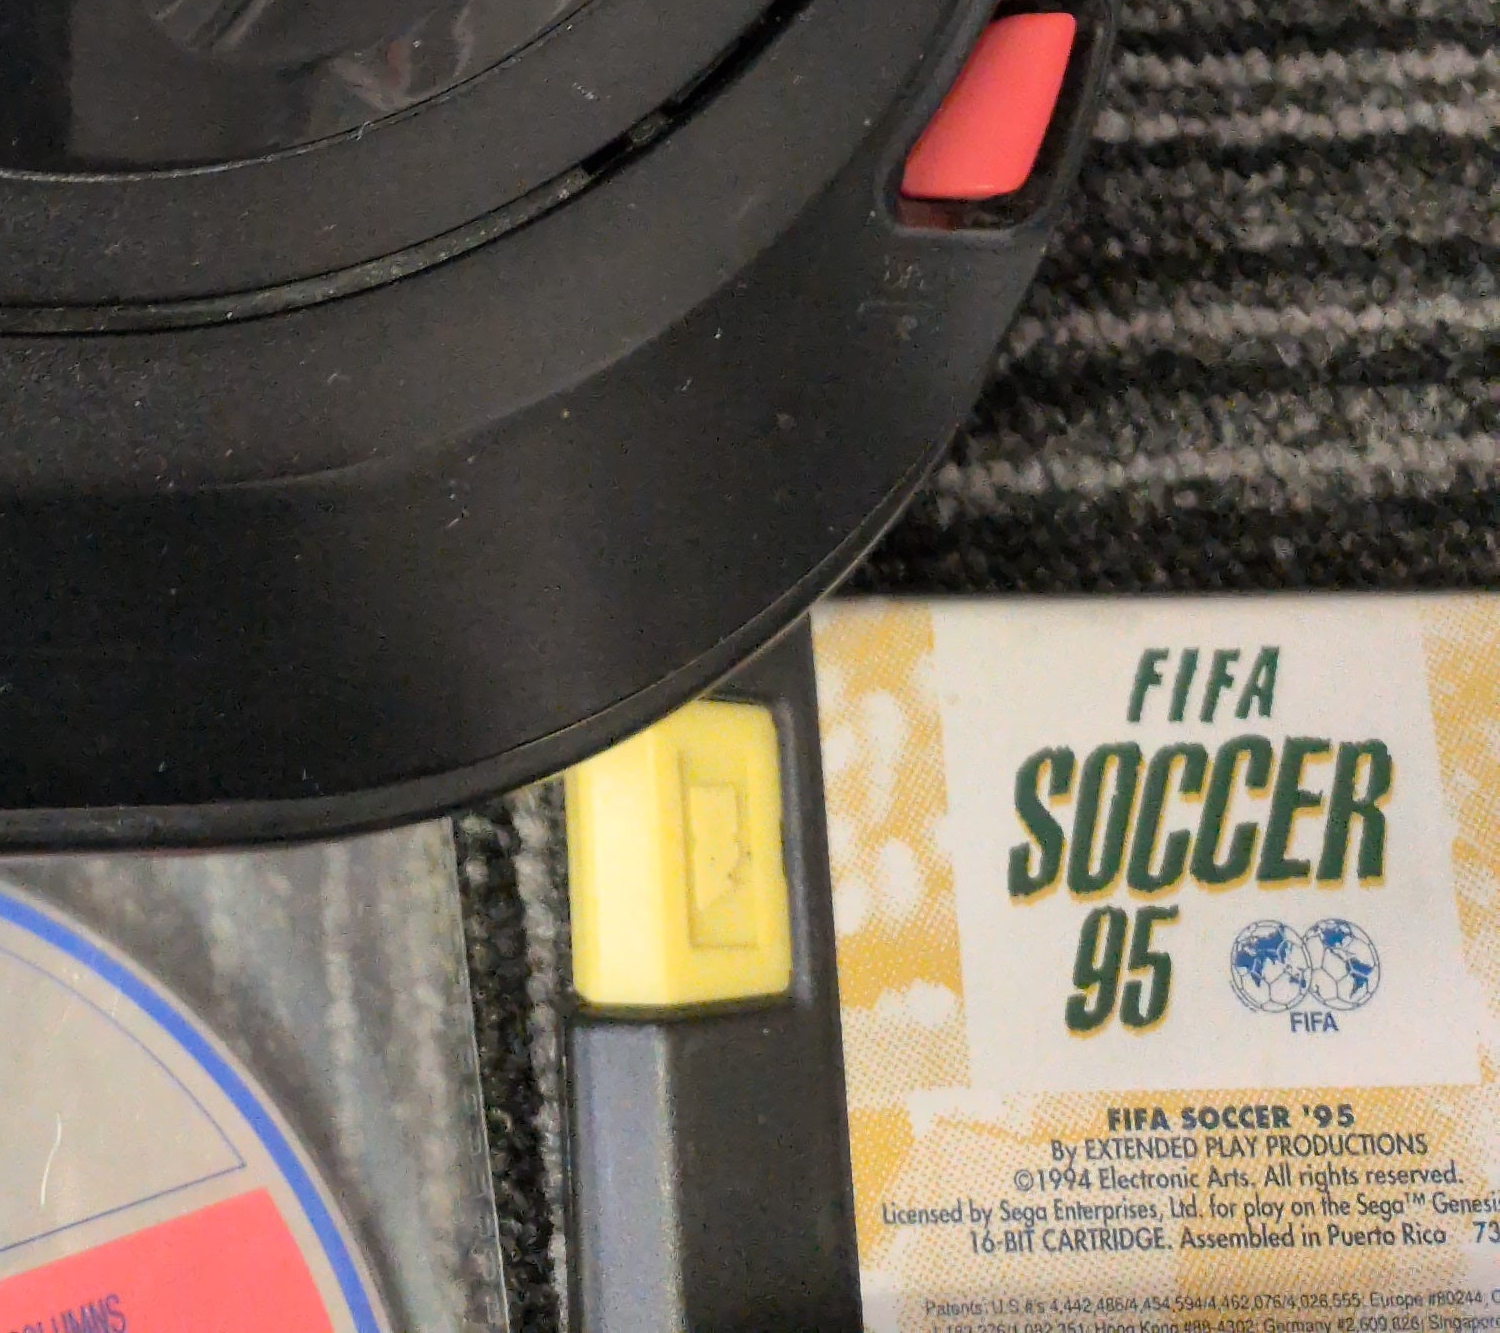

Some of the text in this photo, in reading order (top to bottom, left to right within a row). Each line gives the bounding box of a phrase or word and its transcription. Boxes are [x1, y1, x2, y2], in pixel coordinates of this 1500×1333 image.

[1128, 646, 1280, 723] FIFA
[1008, 734, 1395, 901] SOCCER
[1065, 905, 1180, 1037] 95
[1289, 1011, 1339, 1033] FIFA
[1106, 1103, 1356, 1132] FIFA SOCCER '95
[1050, 1132, 1428, 1169] By EXTENDED PLAY PRODUCTIONS
[1013, 1158, 1465, 1193] ©1994 Electronic Arts. All rights reserved.
[883, 1198, 964, 1226] Licensed
[970, 1200, 994, 1229] by
[1000, 1199, 1049, 1228] Sega
[1054, 1196, 1164, 1226] Enterprises,
[1169, 1193, 1205, 1219] Ltd.
[1209, 1194, 1237, 1219] for
[1244, 1192, 1285, 1226] play
[1291, 1200, 1315, 1217] on
[1321, 1191, 1351, 1217] the
[971, 1229, 1034, 1254] 16-BIT
[1041, 1226, 1173, 1251] CARTRIDGE.
[1180, 1222, 1294, 1249] Assembled
[1301, 1222, 1322, 1247] in
[1328, 1223, 1396, 1247] Puerto
[1402, 1220, 1447, 1245] Rico
